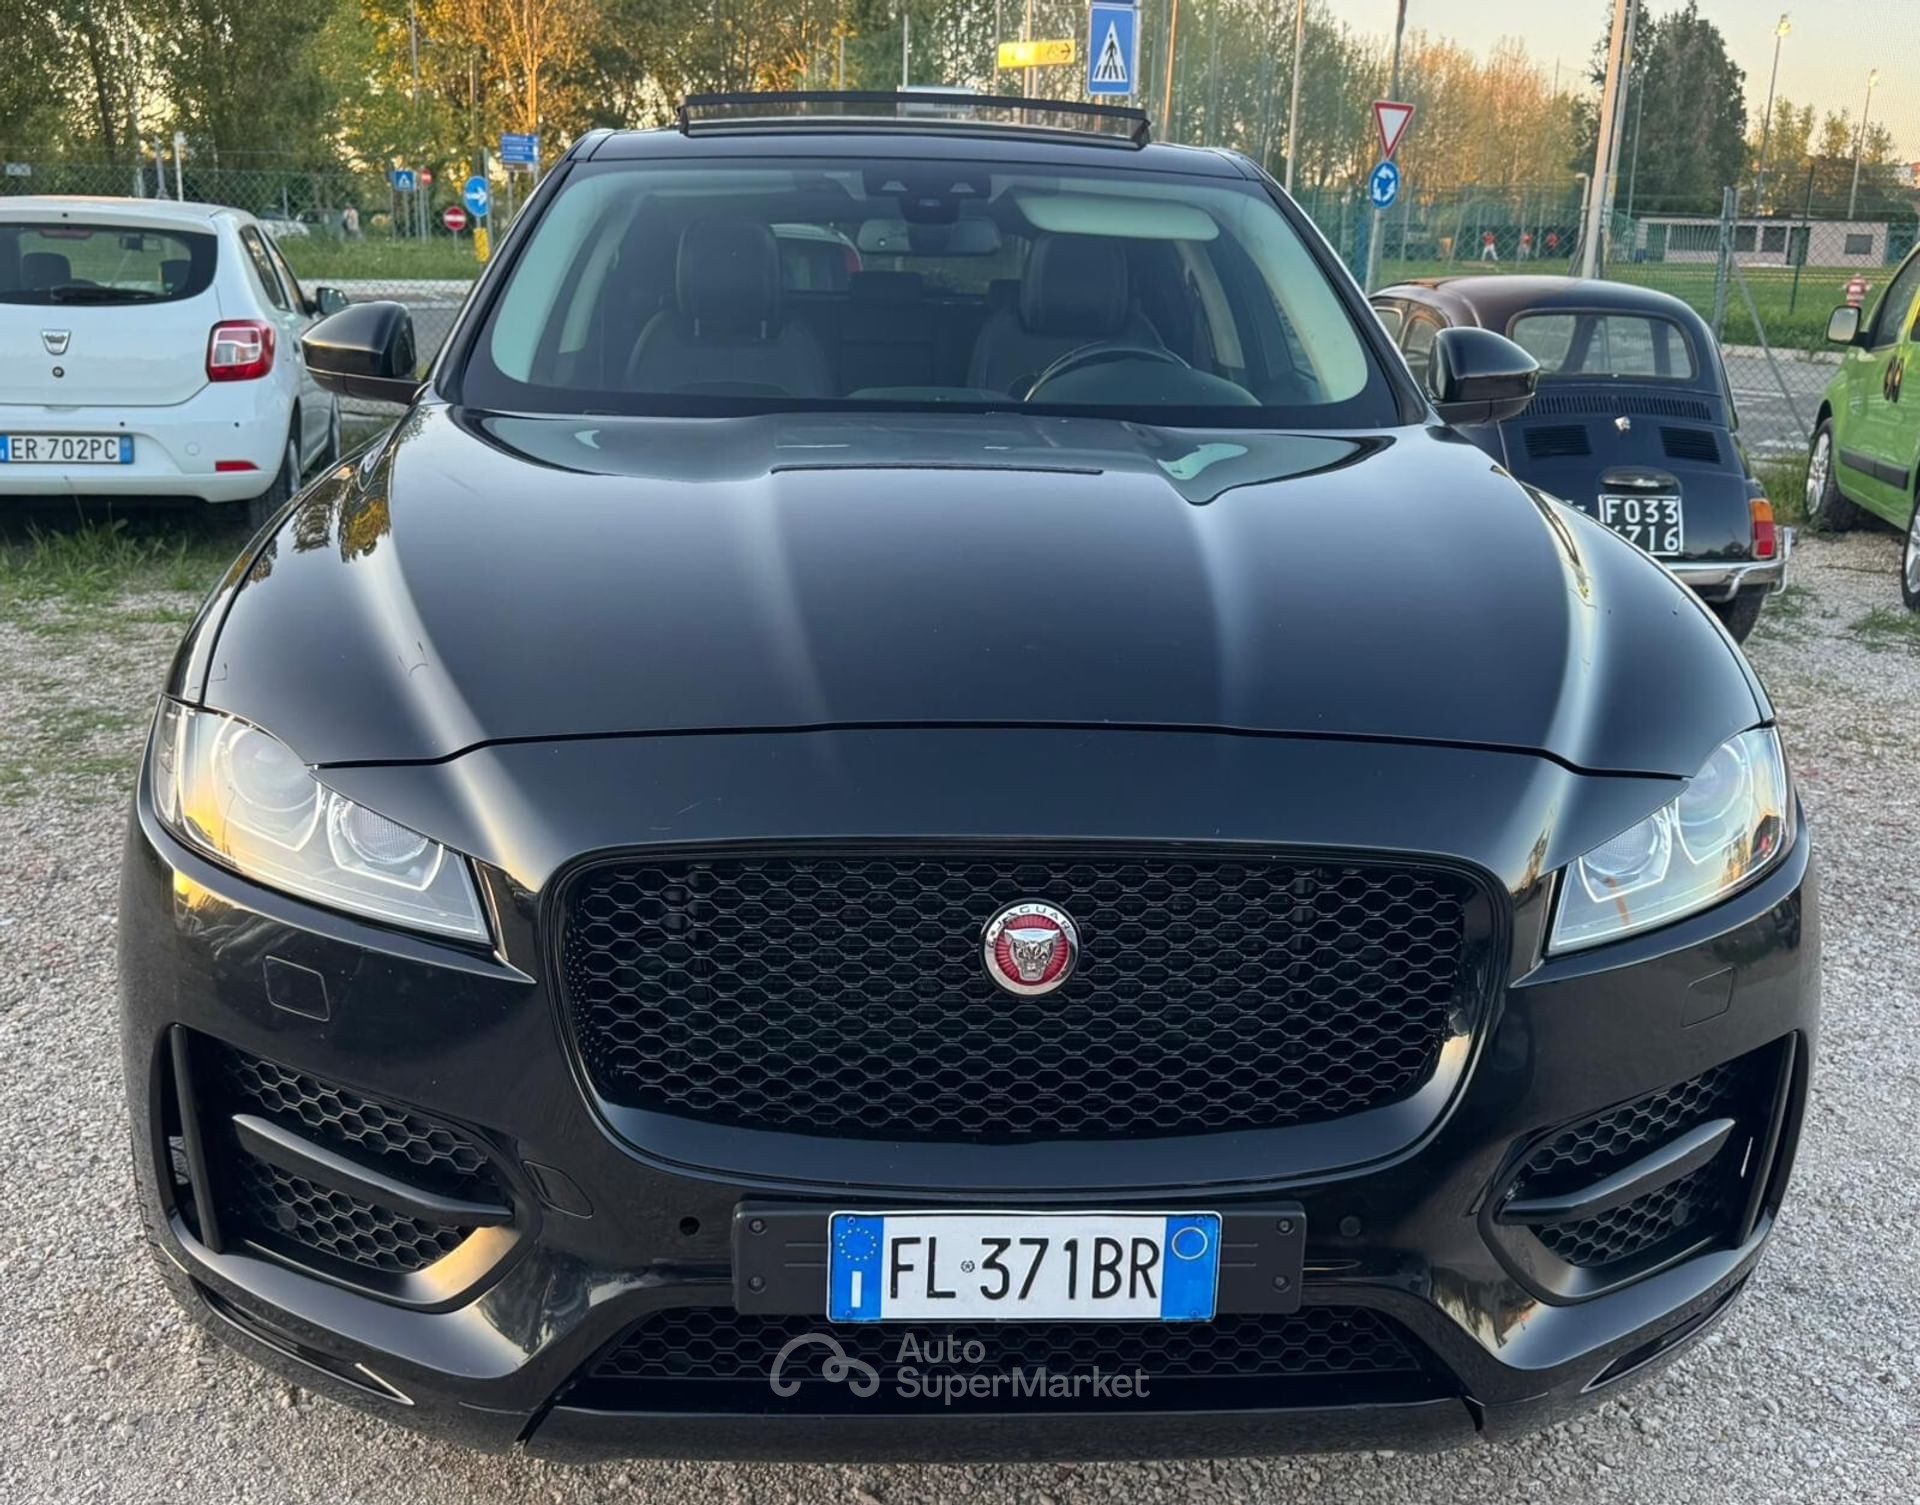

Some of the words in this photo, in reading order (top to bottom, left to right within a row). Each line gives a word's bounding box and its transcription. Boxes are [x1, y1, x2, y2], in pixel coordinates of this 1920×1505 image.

[47, 438, 117, 460] 702PC
[1614, 525, 1679, 552] 716
[997, 905, 1071, 931] JAGUAR
[979, 1237, 1161, 1301] 371BR
